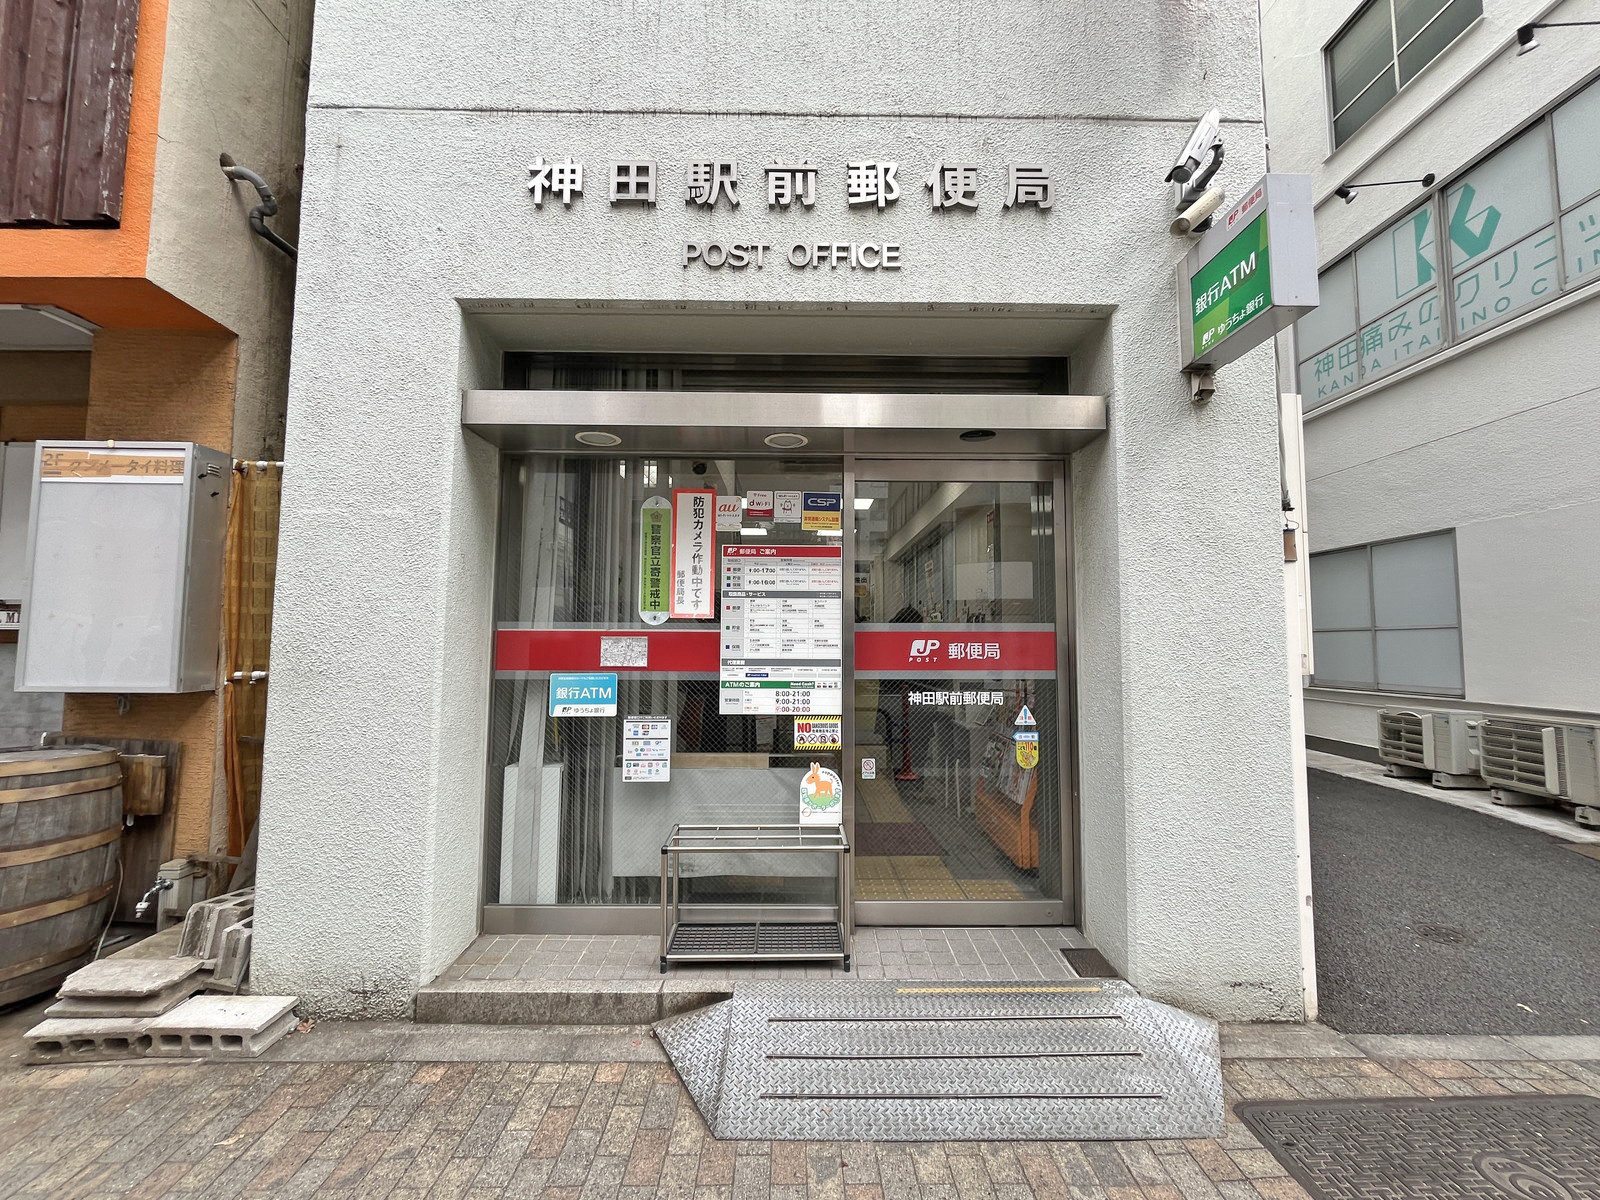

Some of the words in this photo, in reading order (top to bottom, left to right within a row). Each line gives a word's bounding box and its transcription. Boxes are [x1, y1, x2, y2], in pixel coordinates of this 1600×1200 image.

[527, 157, 1056, 210] 神田駅前郵便局
[682, 242, 769, 269] POST
[787, 242, 902, 270] OFFICE
[1195, 251, 1256, 316] 銀行ATM
[1217, 292, 1265, 336] ゆうちょ銀行
[719, 503, 740, 512] au
[807, 497, 837, 507] CSP
[649, 523, 662, 610] 警察官立寄警戒中
[691, 496, 705, 611] 防犯カメラ作動中です
[676, 570, 686, 605] 郵便局長
[910, 640, 941, 657] JP
[948, 642, 1001, 660] 郵便局
[556, 687, 612, 699] 銀行ATM
[908, 691, 1004, 706] 神田駅前郵便局
[797, 722, 812, 733] NO
